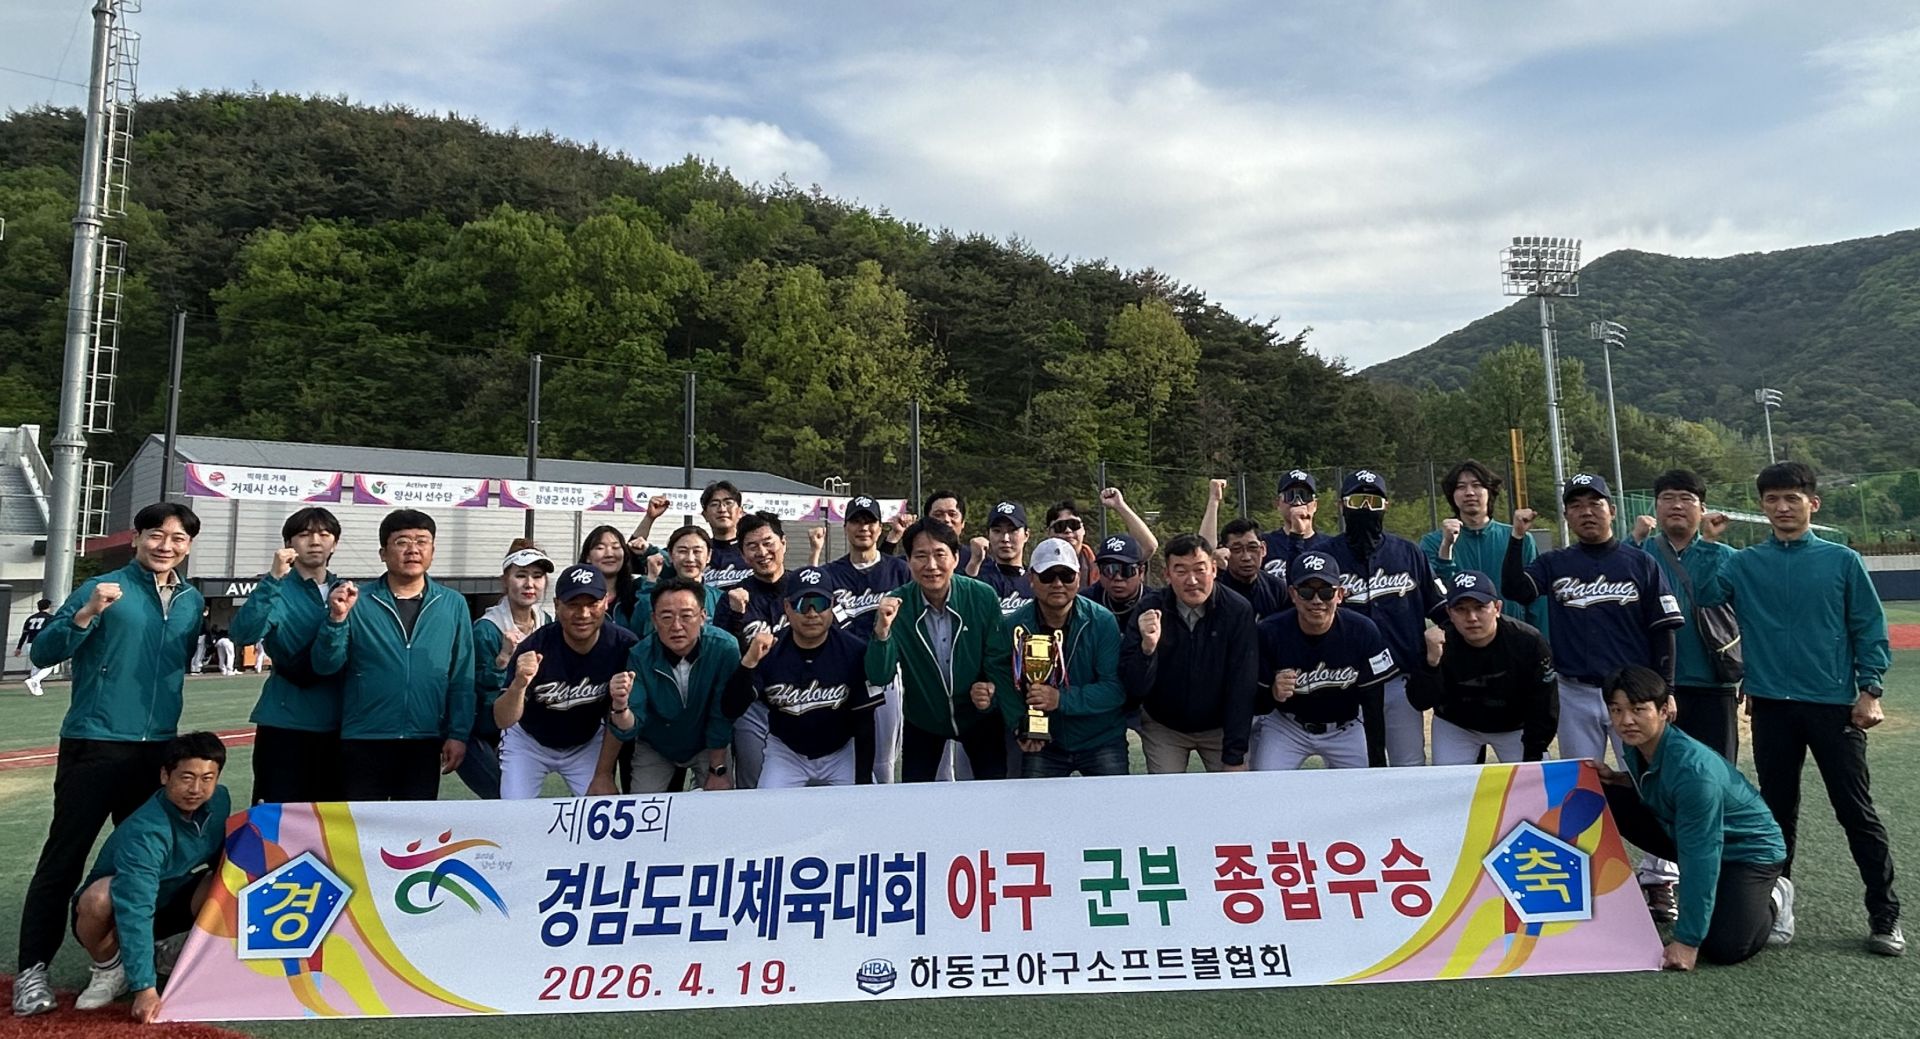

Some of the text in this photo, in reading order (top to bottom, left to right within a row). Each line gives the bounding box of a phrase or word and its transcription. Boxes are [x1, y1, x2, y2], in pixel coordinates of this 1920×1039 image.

[231, 482, 264, 494] 거제시
[267, 485, 299, 496] 선수단
[394, 490, 452, 502] 양산시 선수단
[536, 494, 585, 506] 창녕군 선수단
[676, 500, 698, 511] 선수단
[571, 568, 594, 584] HB
[799, 568, 822, 585] HB
[833, 587, 891, 608] Hadon
[1552, 575, 1640, 607] Hadong
[29, 617, 46, 630] 77
[1296, 661, 1359, 690] adong
[534, 676, 610, 705] Hadon
[765, 679, 850, 710] Hadong
[547, 796, 673, 844] 제65회
[1514, 847, 1572, 904] 축
[538, 838, 1434, 947] 경남도민체육대회 야구 군부 종합우승
[263, 881, 323, 942] 경
[538, 960, 796, 1001] 2026. 4. 19.
[864, 962, 890, 975] HBA
[910, 943, 1293, 989] 하동군야구소프트볼협회
